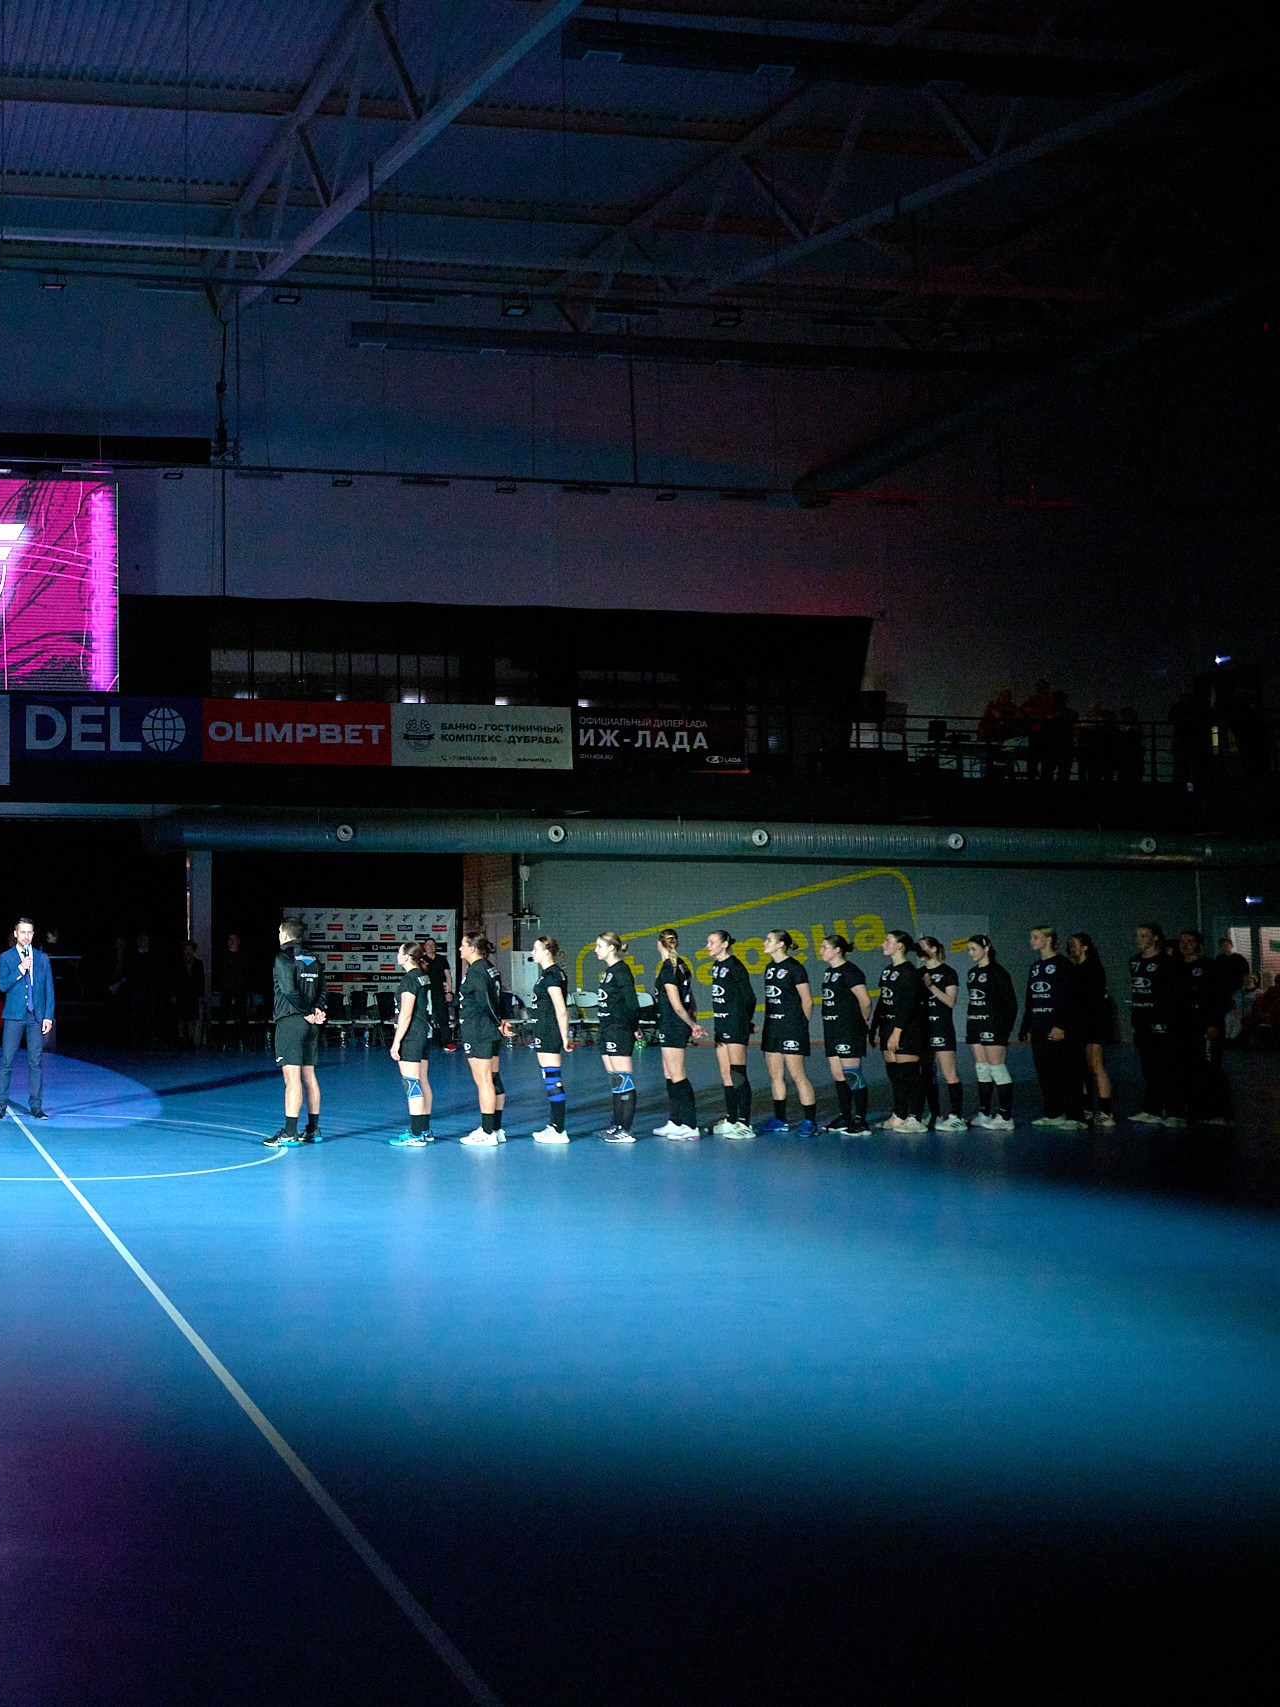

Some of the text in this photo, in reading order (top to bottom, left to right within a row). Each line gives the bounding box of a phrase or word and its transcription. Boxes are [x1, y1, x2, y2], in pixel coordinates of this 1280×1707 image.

[440, 722, 477, 731] БАННО
[579, 716, 708, 728] ОФИЦИАЛЬНЫЙ ДИЛЕР LADA
[208, 720, 386, 747] OLIMPBET
[440, 733, 502, 743] КОМПЛЕКС
[578, 728, 709, 753] ИЖ-ЛАДА
